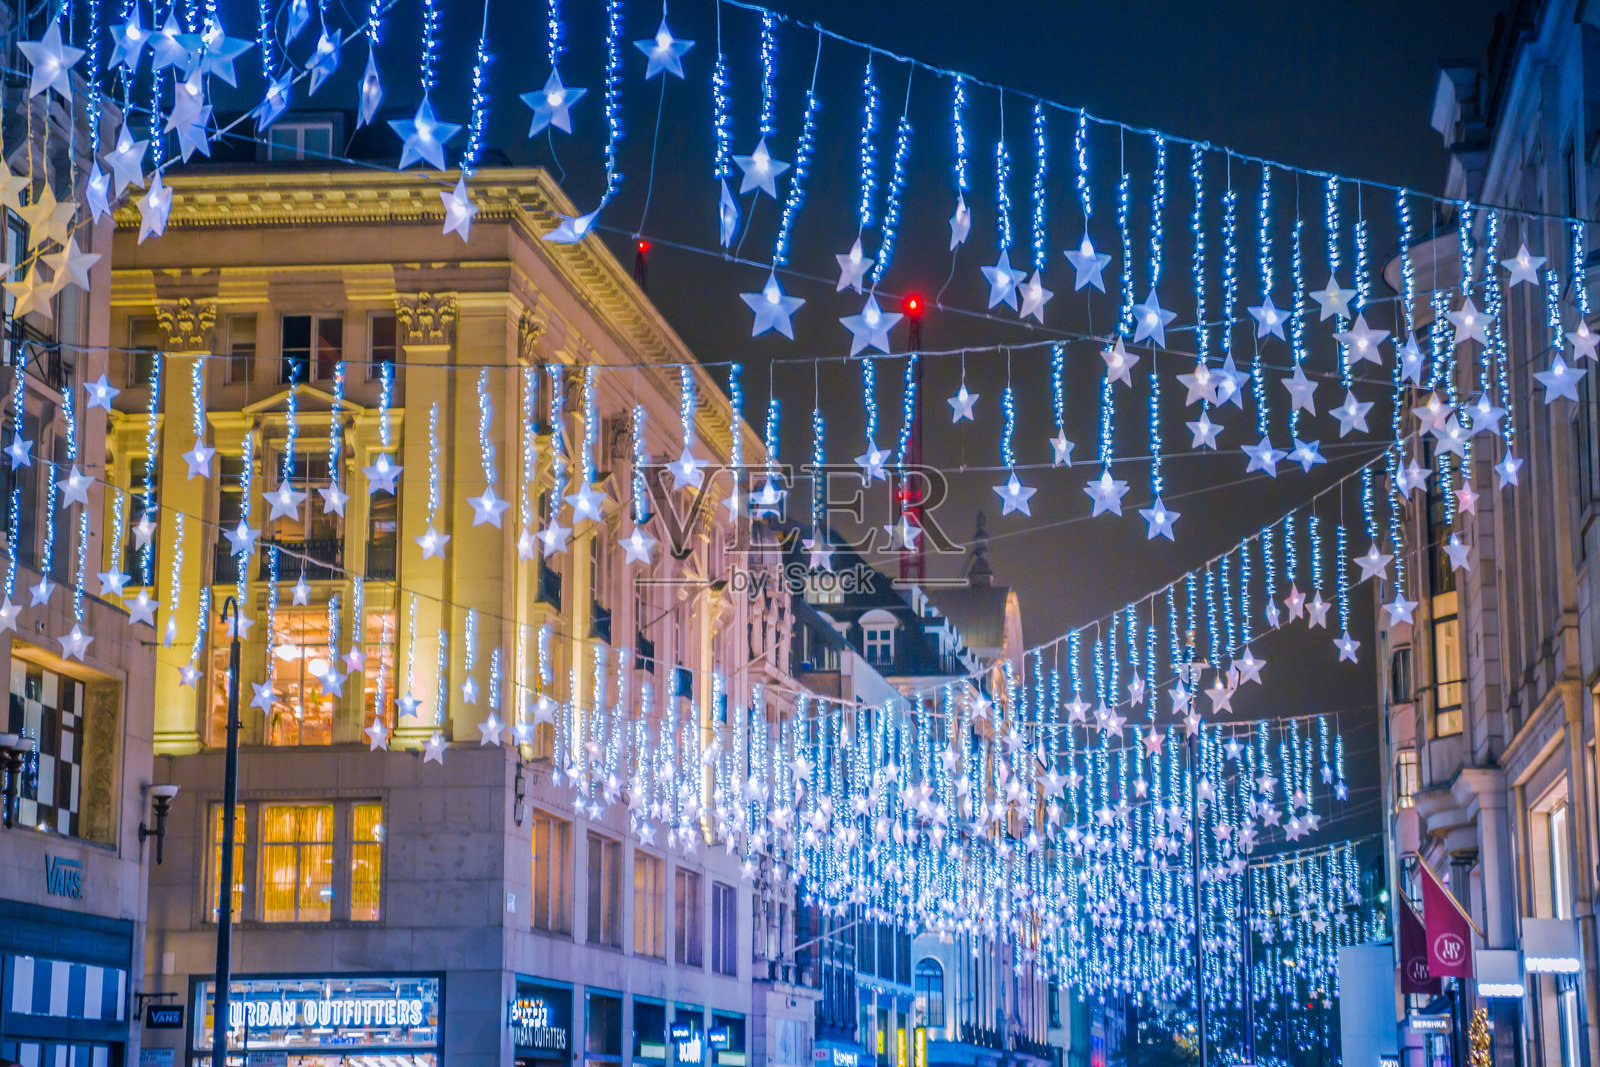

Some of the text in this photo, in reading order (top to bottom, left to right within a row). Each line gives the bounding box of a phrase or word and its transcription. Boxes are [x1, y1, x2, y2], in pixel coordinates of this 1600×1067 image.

[45, 853, 83, 900] VANS
[151, 1011, 180, 1023] VANS
[227, 1000, 423, 1037] URBAN OUTFITTERS
